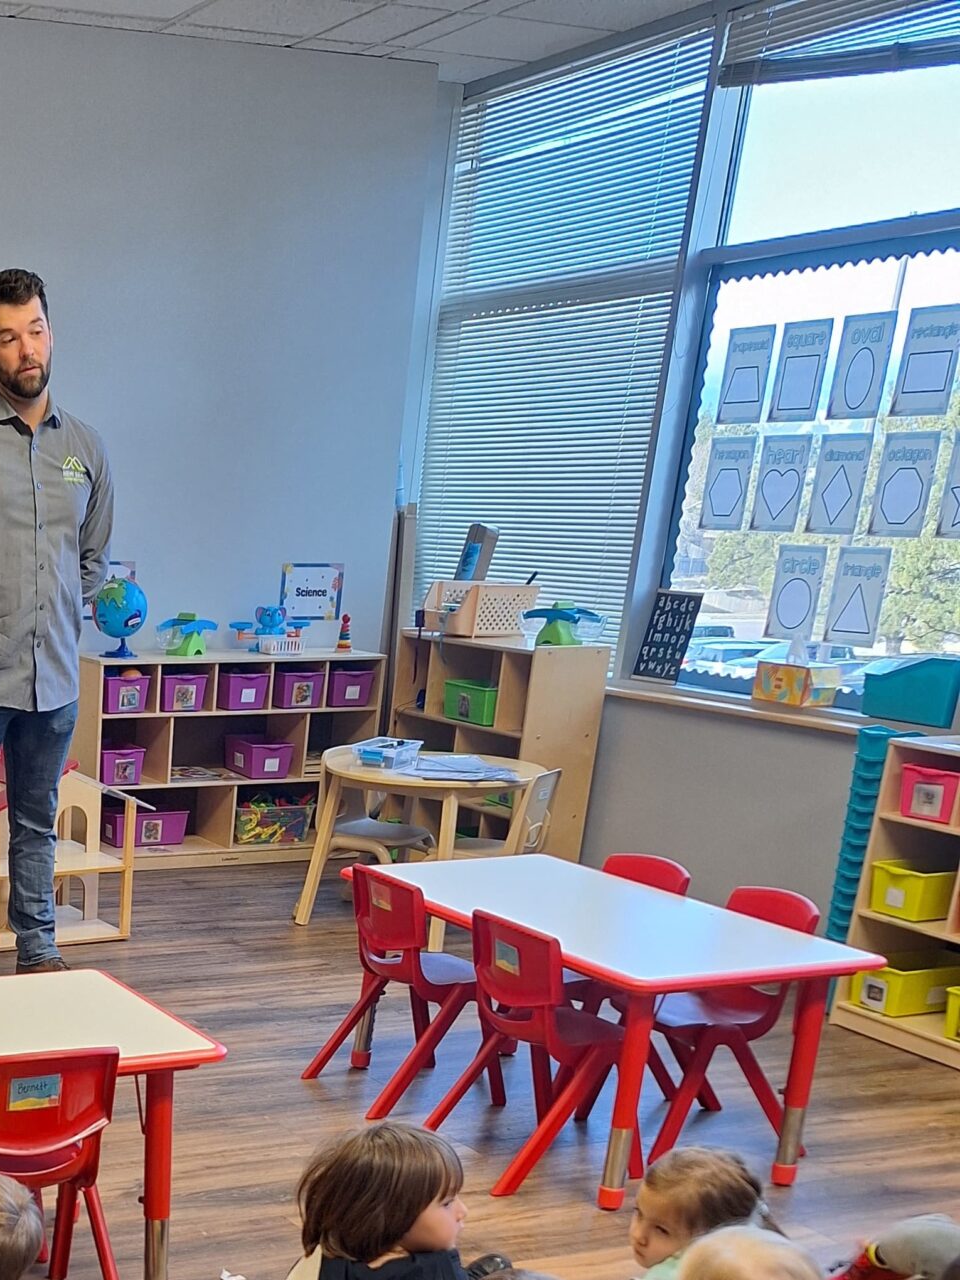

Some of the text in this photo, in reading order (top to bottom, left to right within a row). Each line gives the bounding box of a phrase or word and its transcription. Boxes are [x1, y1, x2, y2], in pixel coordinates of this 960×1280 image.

[787, 330, 827, 351] square
[851, 321, 886, 345] oval
[766, 444, 806, 465] heart
[887, 446, 932, 465] octagon
[783, 555, 820, 576] circle
[842, 562, 882, 581] triangle
[295, 586, 328, 597] Science
[17, 1081, 48, 1095] Bennett
